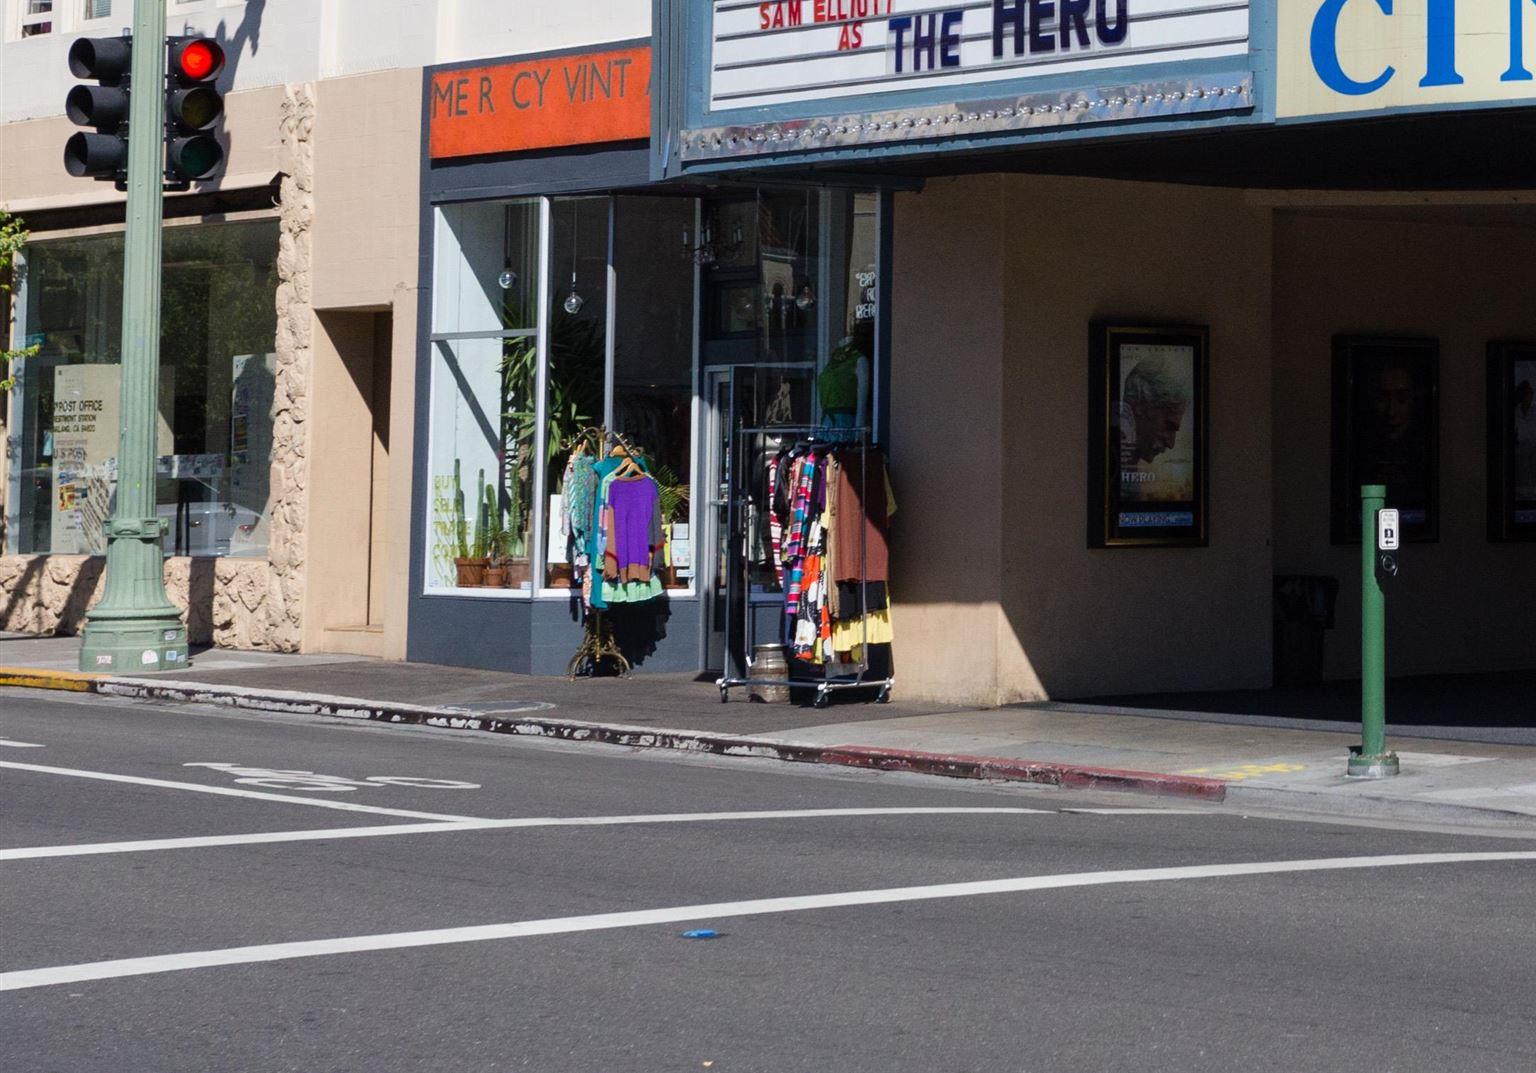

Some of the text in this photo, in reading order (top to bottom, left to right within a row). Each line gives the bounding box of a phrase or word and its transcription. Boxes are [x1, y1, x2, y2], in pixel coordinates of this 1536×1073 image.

[759, 0, 801, 30] SAM
[837, 21, 863, 52] AS
[888, 11, 964, 73] THE
[563, 59, 651, 107] VINT
[79, 399, 103, 412] OFFICE
